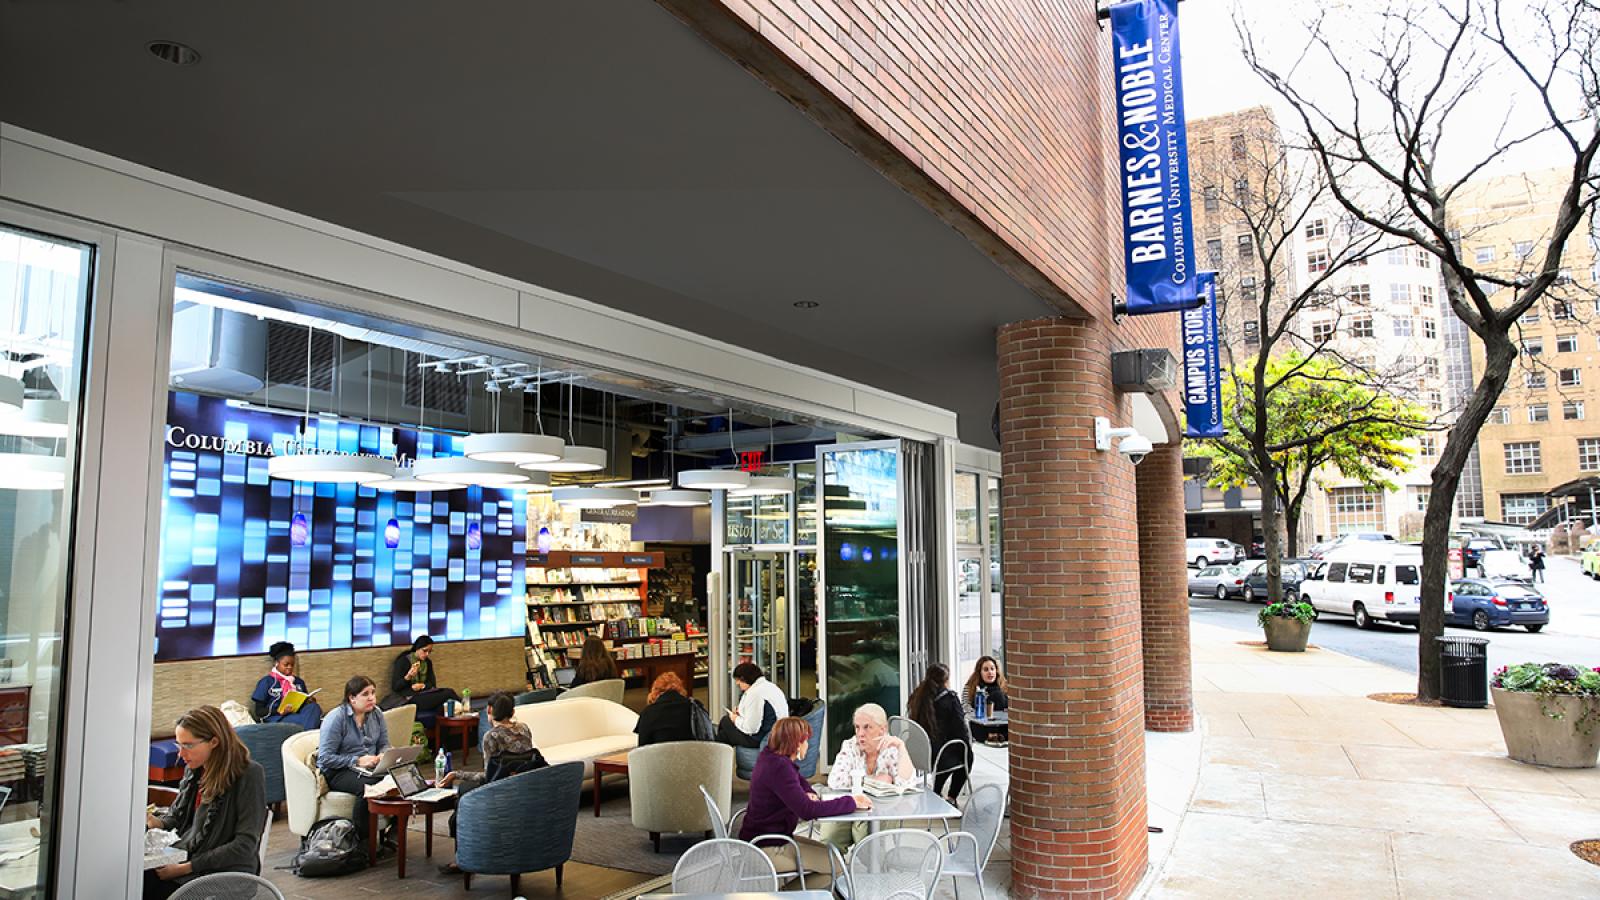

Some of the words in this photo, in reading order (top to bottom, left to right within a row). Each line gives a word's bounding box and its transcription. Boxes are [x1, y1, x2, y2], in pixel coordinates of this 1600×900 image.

[1157, 13, 1172, 64] CENTER
[1161, 66, 1176, 125] MEDICAL
[1119, 37, 1167, 264] BARNES&NOBLE
[1167, 130, 1181, 210] UNIVERSITY
[1171, 211, 1187, 285] COLUMBIA
[1184, 307, 1205, 346] STOR
[1186, 349, 1208, 405] CAMPUS
[167, 426, 274, 457] COLUMBIA
[740, 451, 765, 472] EXIT
[727, 522, 770, 540] ustoer
